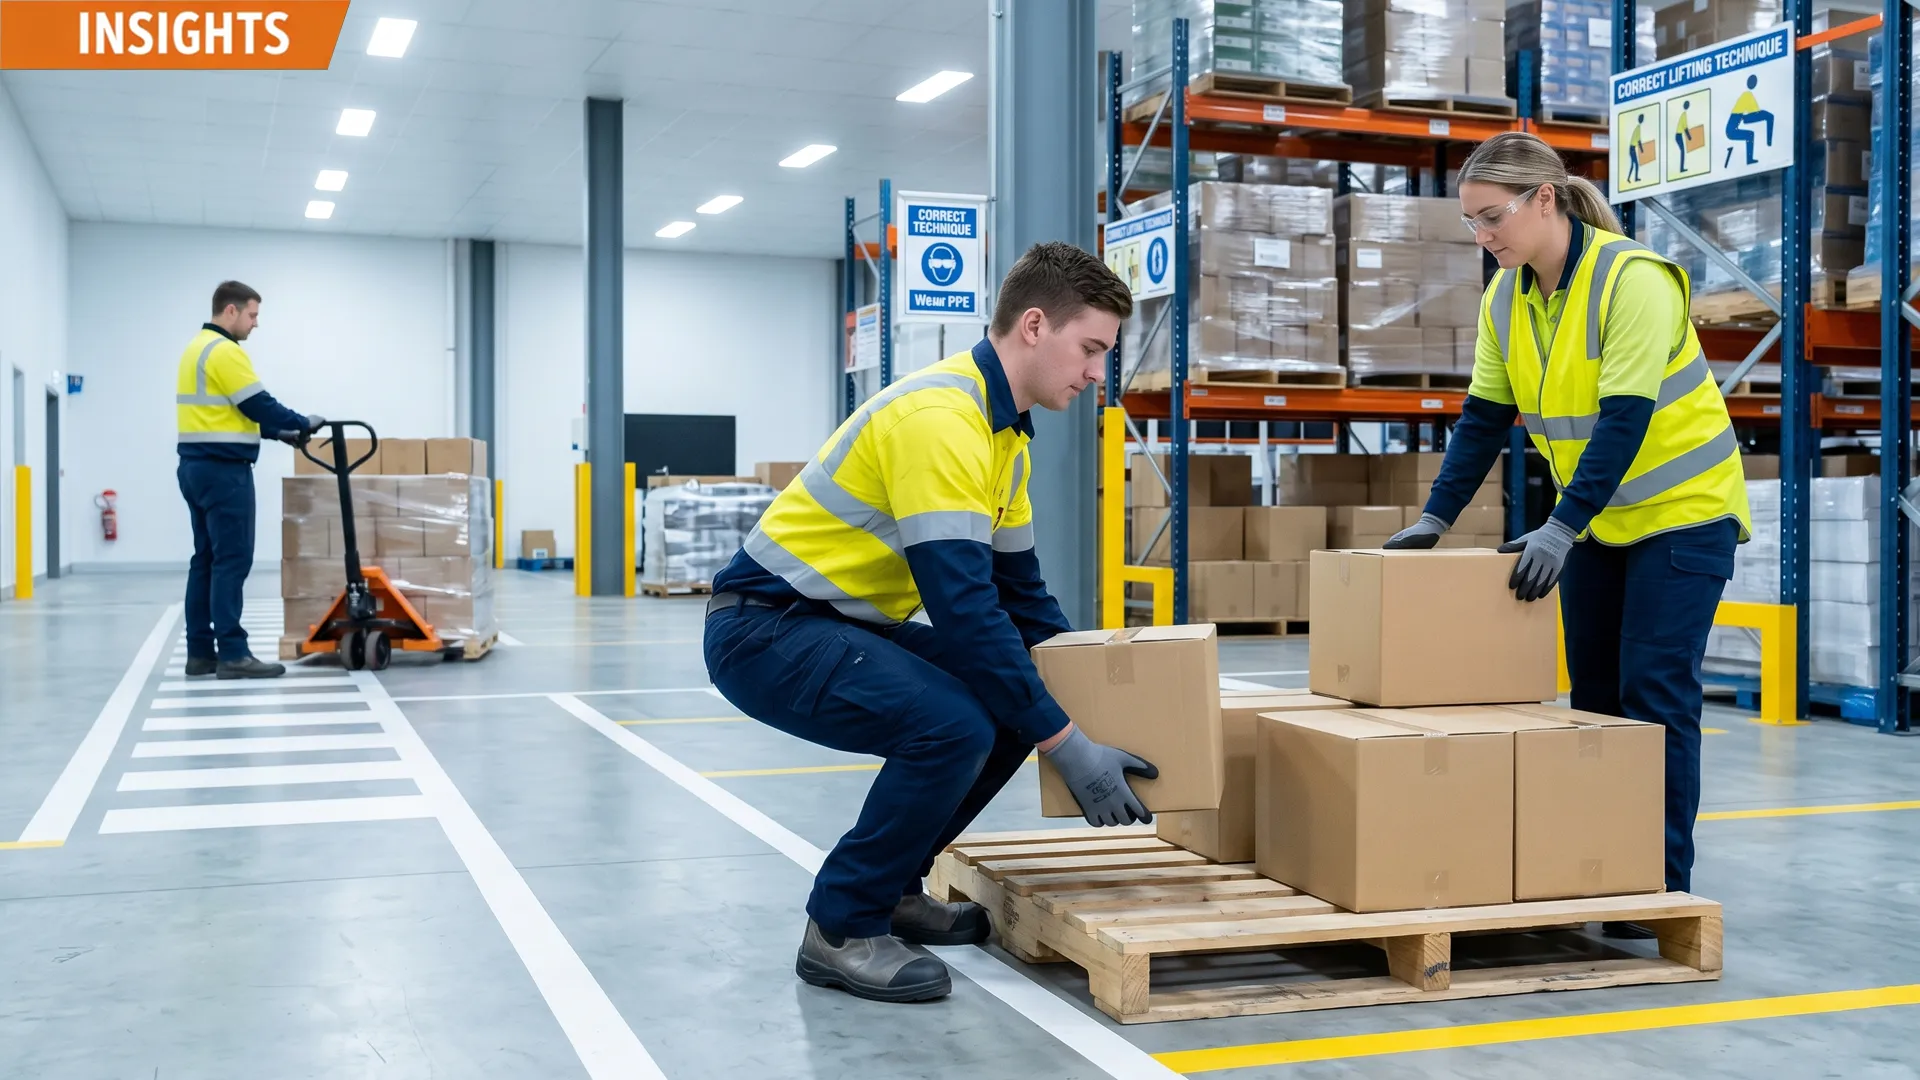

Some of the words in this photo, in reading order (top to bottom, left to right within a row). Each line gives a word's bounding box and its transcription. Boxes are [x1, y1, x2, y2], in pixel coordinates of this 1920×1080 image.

[1617, 70, 1666, 100] CORRECT
[1668, 57, 1712, 83] LIFTING
[1714, 35, 1783, 69] TECHNIQUE
[918, 209, 966, 223] CORRECT
[913, 221, 971, 236] TECHNIQUE
[948, 295, 970, 309] PPE
